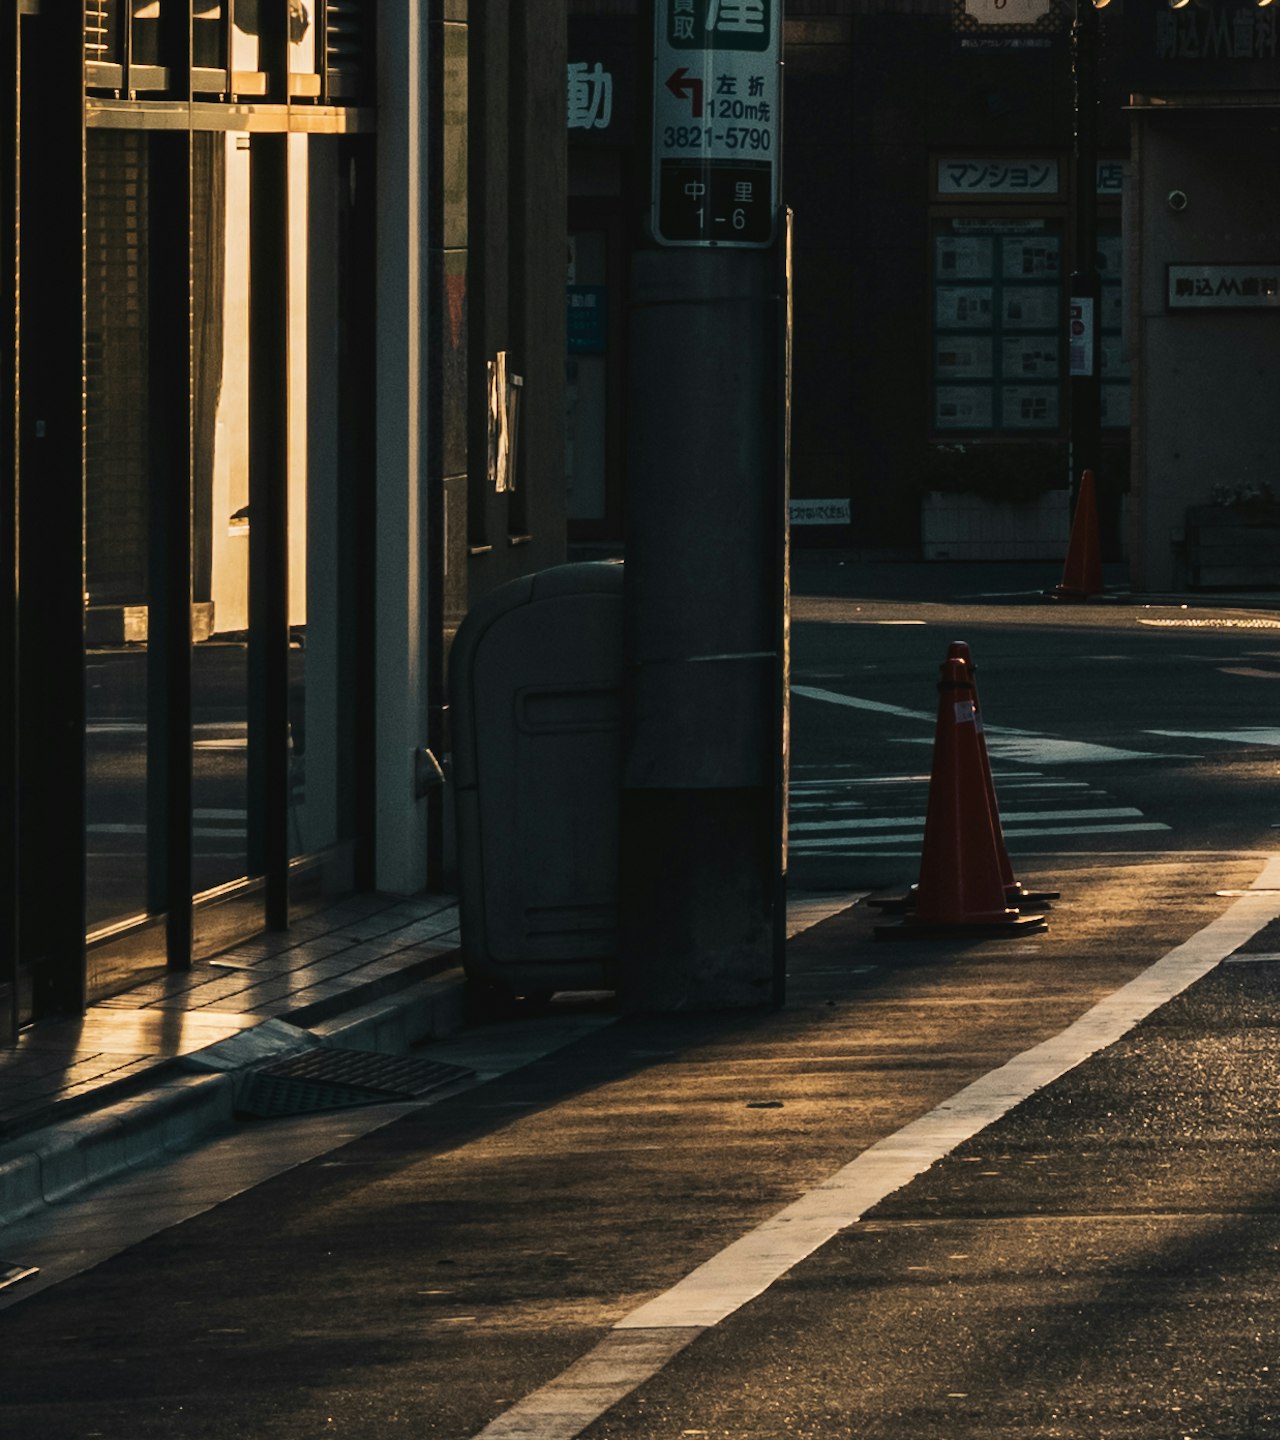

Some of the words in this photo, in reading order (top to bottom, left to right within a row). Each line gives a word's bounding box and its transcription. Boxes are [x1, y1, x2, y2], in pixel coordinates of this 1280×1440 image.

[664, 126, 770, 150] 3821-5790
[947, 164, 1049, 187] マンション
[684, 180, 753, 202] 中里
